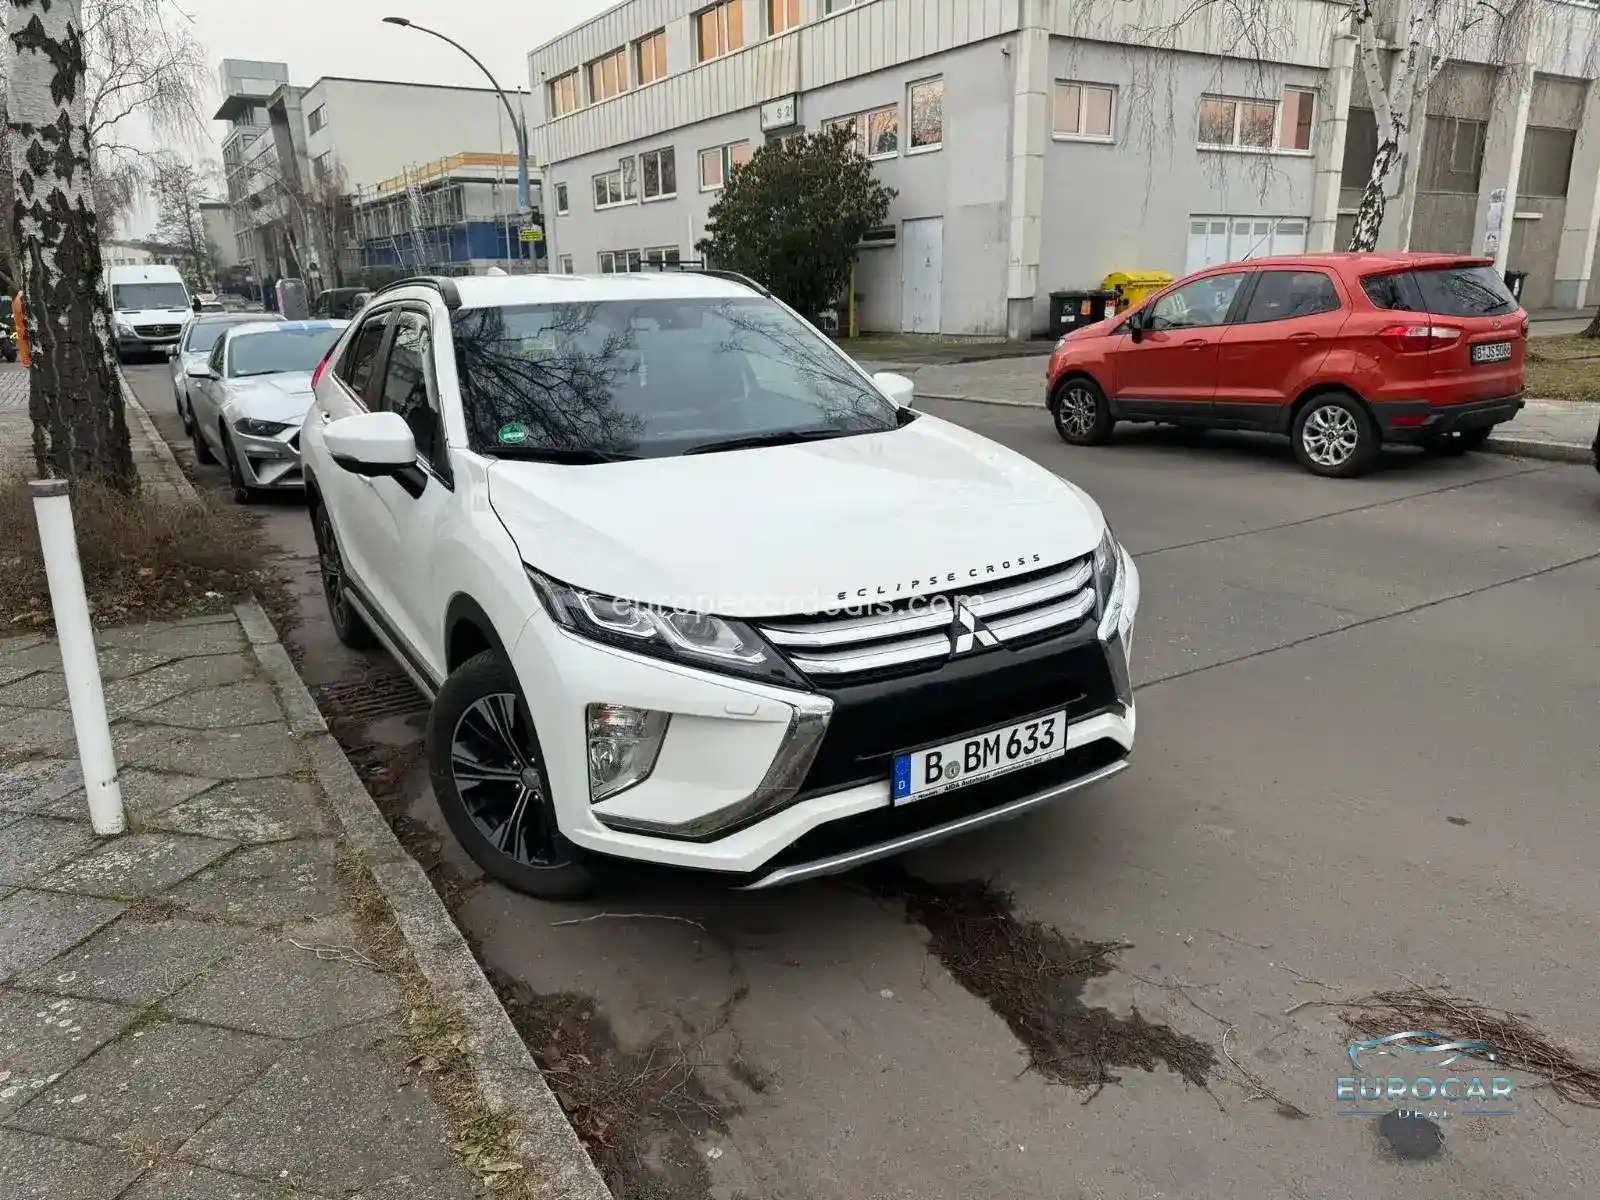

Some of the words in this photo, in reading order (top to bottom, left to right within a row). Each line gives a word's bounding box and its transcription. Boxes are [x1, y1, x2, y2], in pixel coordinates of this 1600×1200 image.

[837, 572, 956, 600] ECLIPSE
[969, 553, 1041, 578] CROSS
[925, 751, 943, 785] B
[964, 733, 1001, 774] BM
[1006, 718, 1055, 760] 633
[898, 780, 906, 790] D
[944, 781, 961, 793] AIDA
